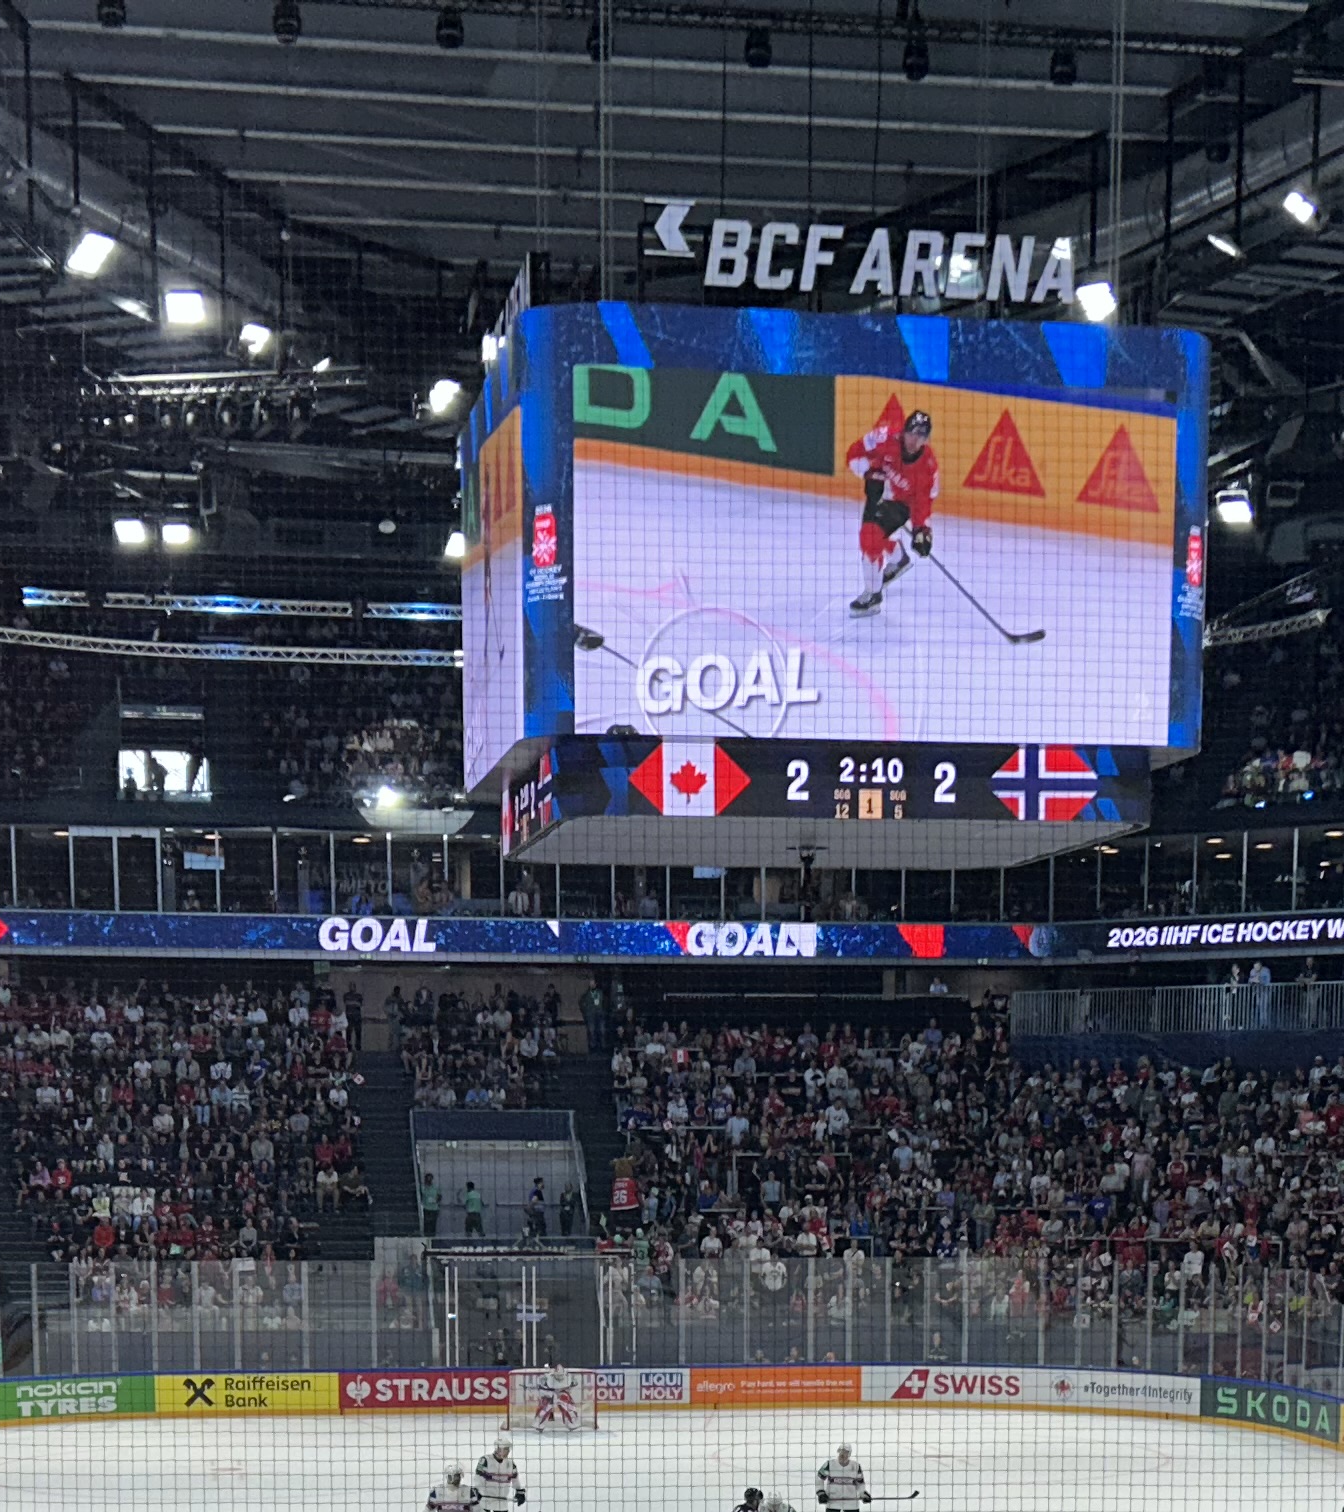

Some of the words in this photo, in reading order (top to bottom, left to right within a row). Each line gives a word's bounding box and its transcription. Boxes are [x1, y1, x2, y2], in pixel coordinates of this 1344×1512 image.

[704, 218, 844, 293] BCF
[849, 228, 1075, 304] ARENA
[636, 648, 821, 716] GOAL
[786, 760, 809, 801] 2
[839, 758, 904, 784] 2:10
[934, 762, 956, 803] 2
[835, 803, 850, 819] 12
[894, 804, 903, 820] 5
[317, 916, 437, 954] GOAL
[1107, 926, 1158, 948] 2026
[1159, 925, 1200, 947] IIHF
[1201, 923, 1236, 945] ICE
[1237, 919, 1327, 944] HOCKEY
[16, 1380, 118, 1398] nokian
[224, 1375, 312, 1393] Raiffeisen
[375, 1375, 508, 1402] STRAUSS
[641, 1374, 682, 1387] LIQUI
[696, 1380, 736, 1394] allegro
[933, 1374, 1020, 1397] SWISS
[224, 1393, 269, 1409] Bank
[641, 1387, 682, 1400] MOLY
[17, 1396, 118, 1417] TYRES
